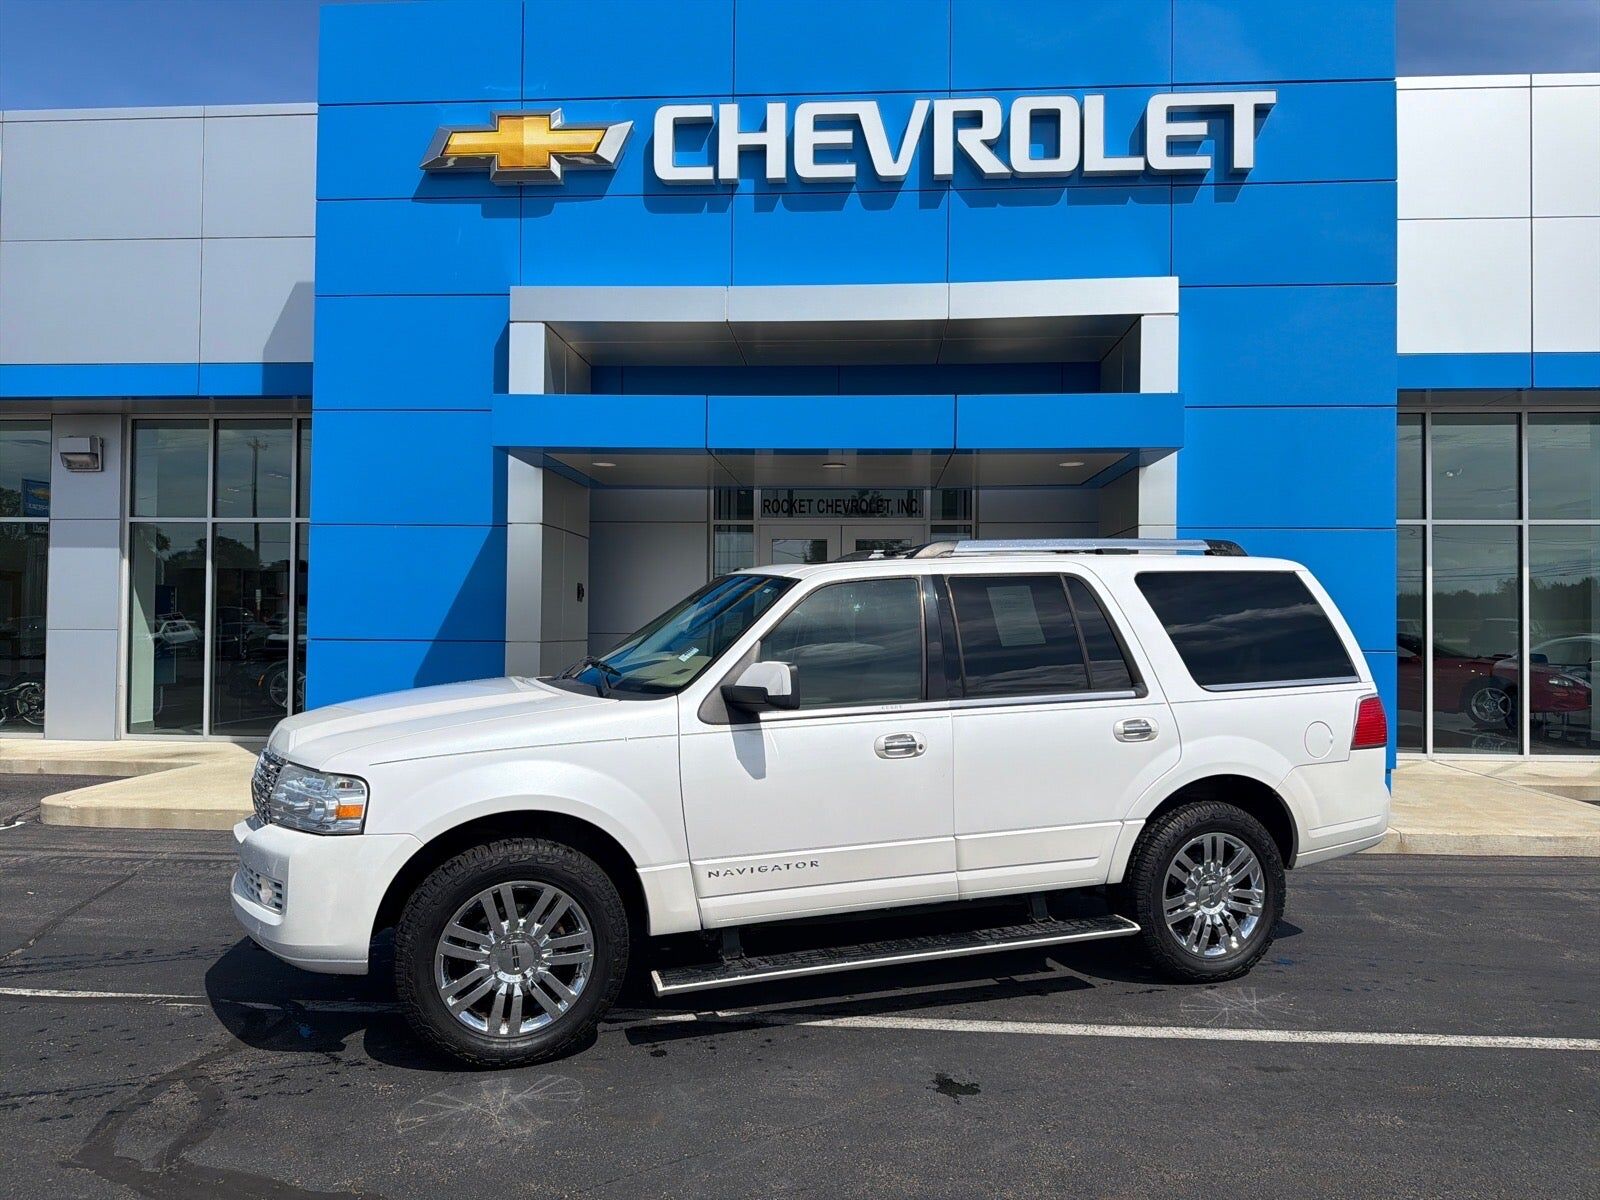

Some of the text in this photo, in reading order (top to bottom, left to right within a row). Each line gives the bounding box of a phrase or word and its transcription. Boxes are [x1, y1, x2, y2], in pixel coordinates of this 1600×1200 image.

[652, 90, 1277, 184] CHEVROLET
[763, 499, 922, 516] ROCKET CHEVROLET, INC.
[707, 860, 820, 878] NAVIGATOR
